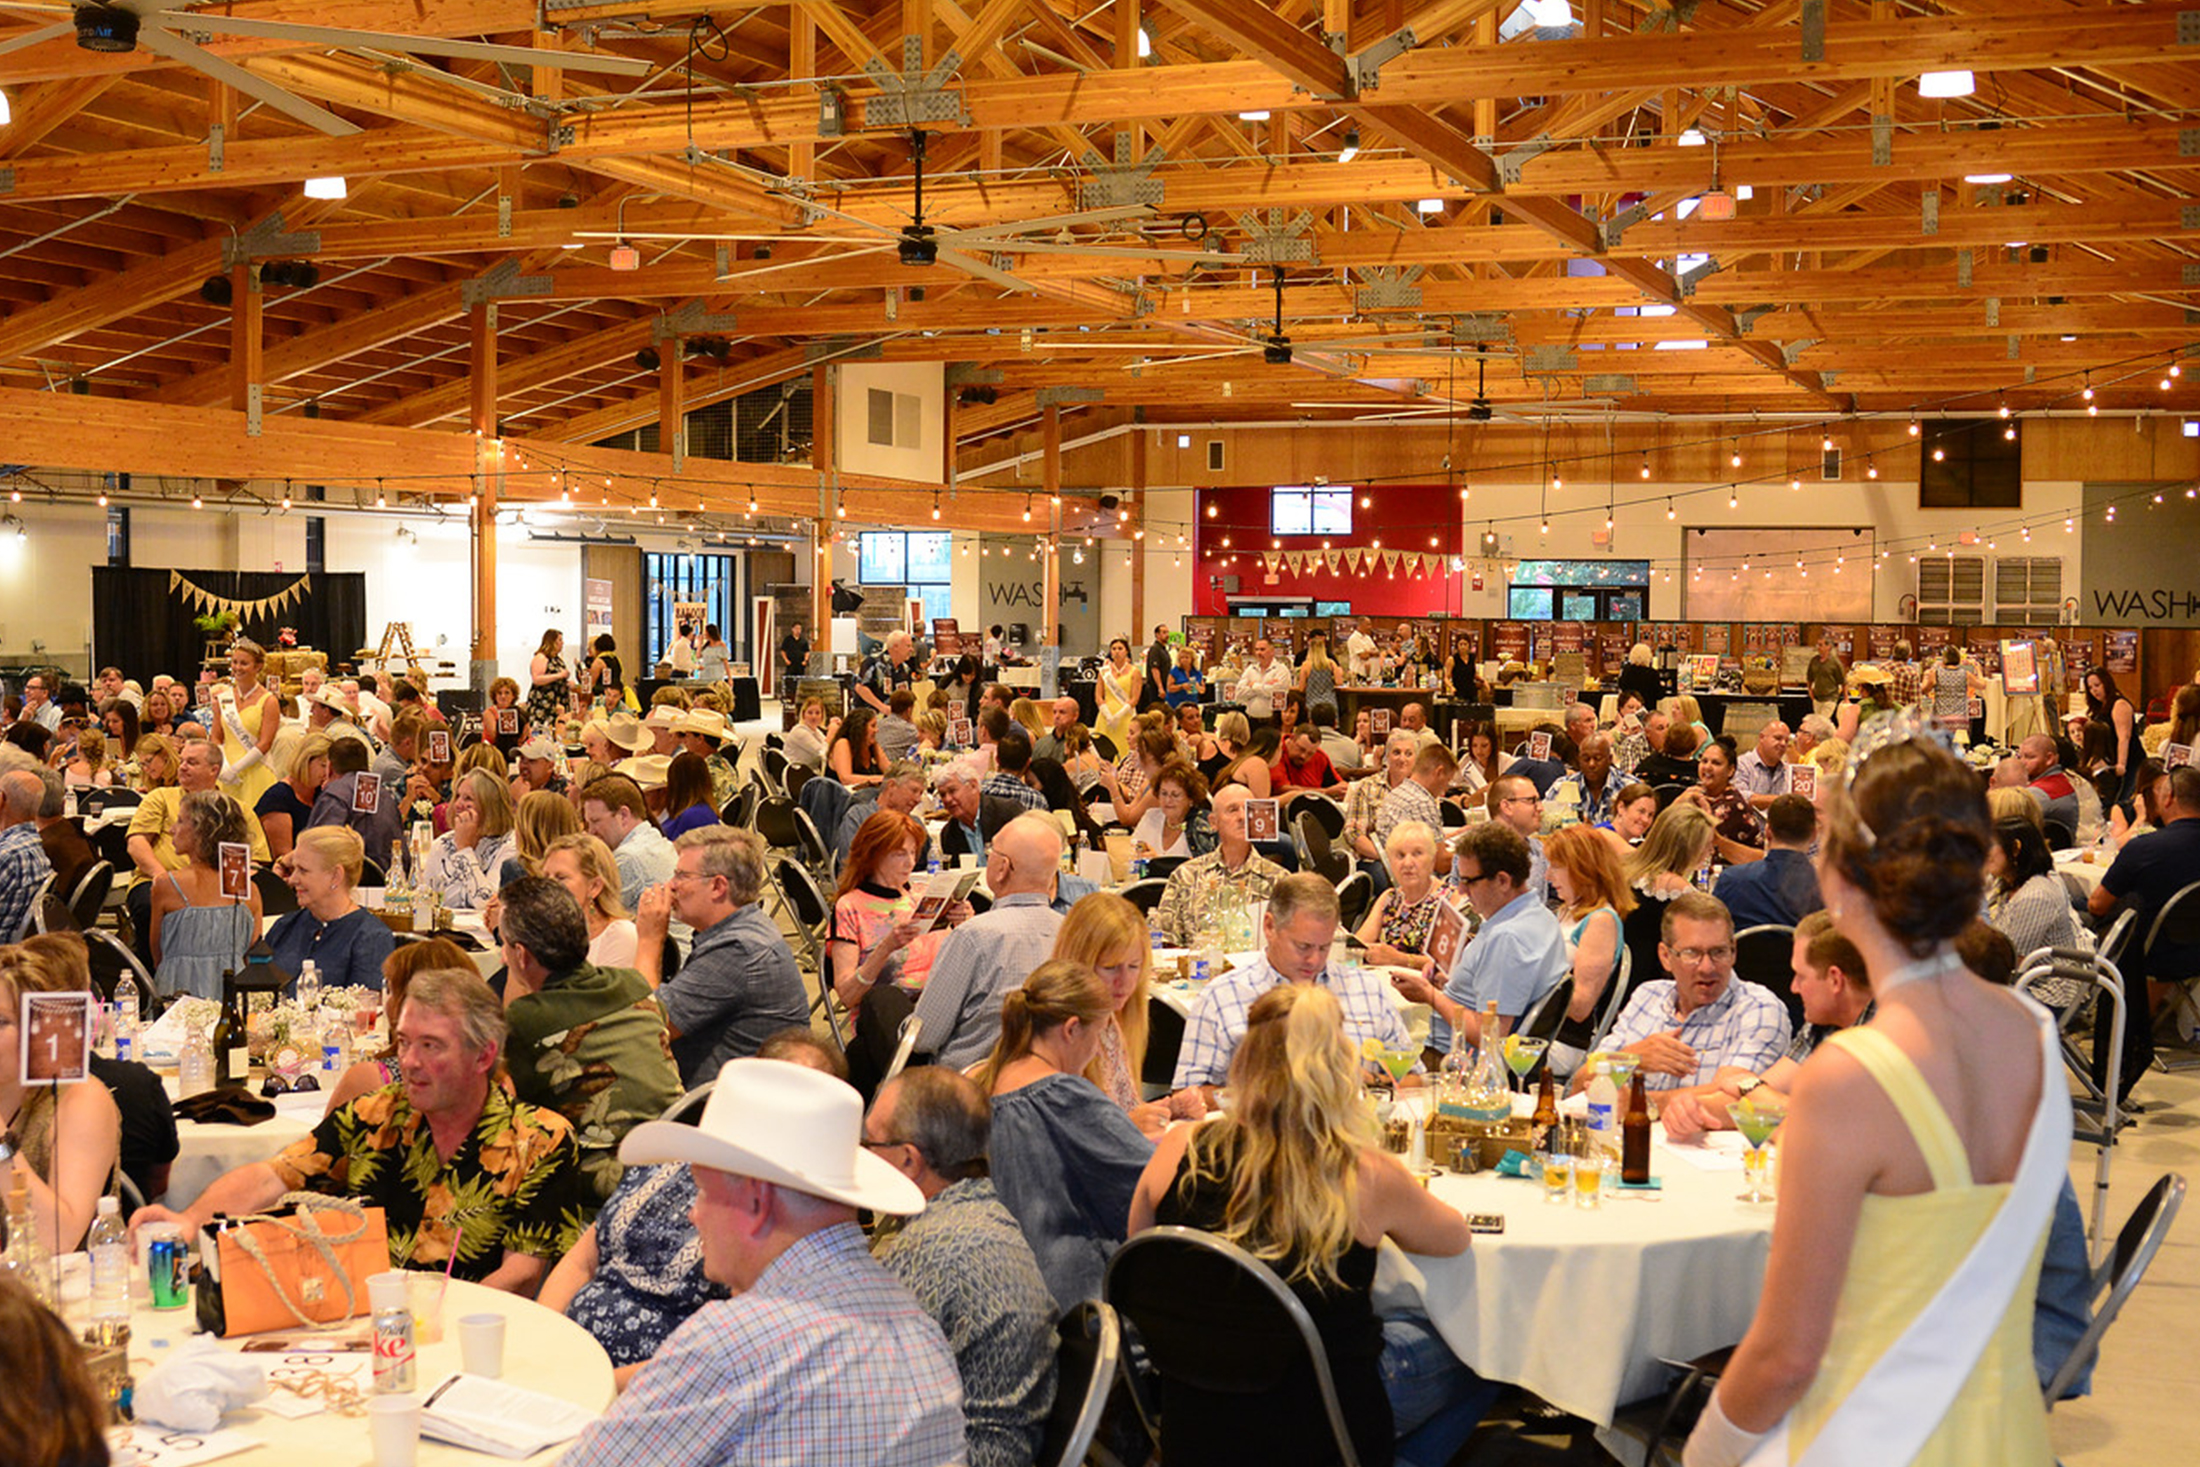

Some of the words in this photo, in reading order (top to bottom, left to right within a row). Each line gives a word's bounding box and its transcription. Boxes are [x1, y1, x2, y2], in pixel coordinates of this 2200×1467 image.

[988, 581, 1063, 607] WAS
[2093, 589, 2192, 619] WASH
[1534, 744, 1546, 754] 22
[1794, 779, 1810, 792] 20
[360, 790, 373, 804] 10
[1254, 817, 1265, 832] 9
[230, 869, 239, 887] 7
[1437, 933, 1449, 955] 8
[46, 1033, 58, 1062] 1
